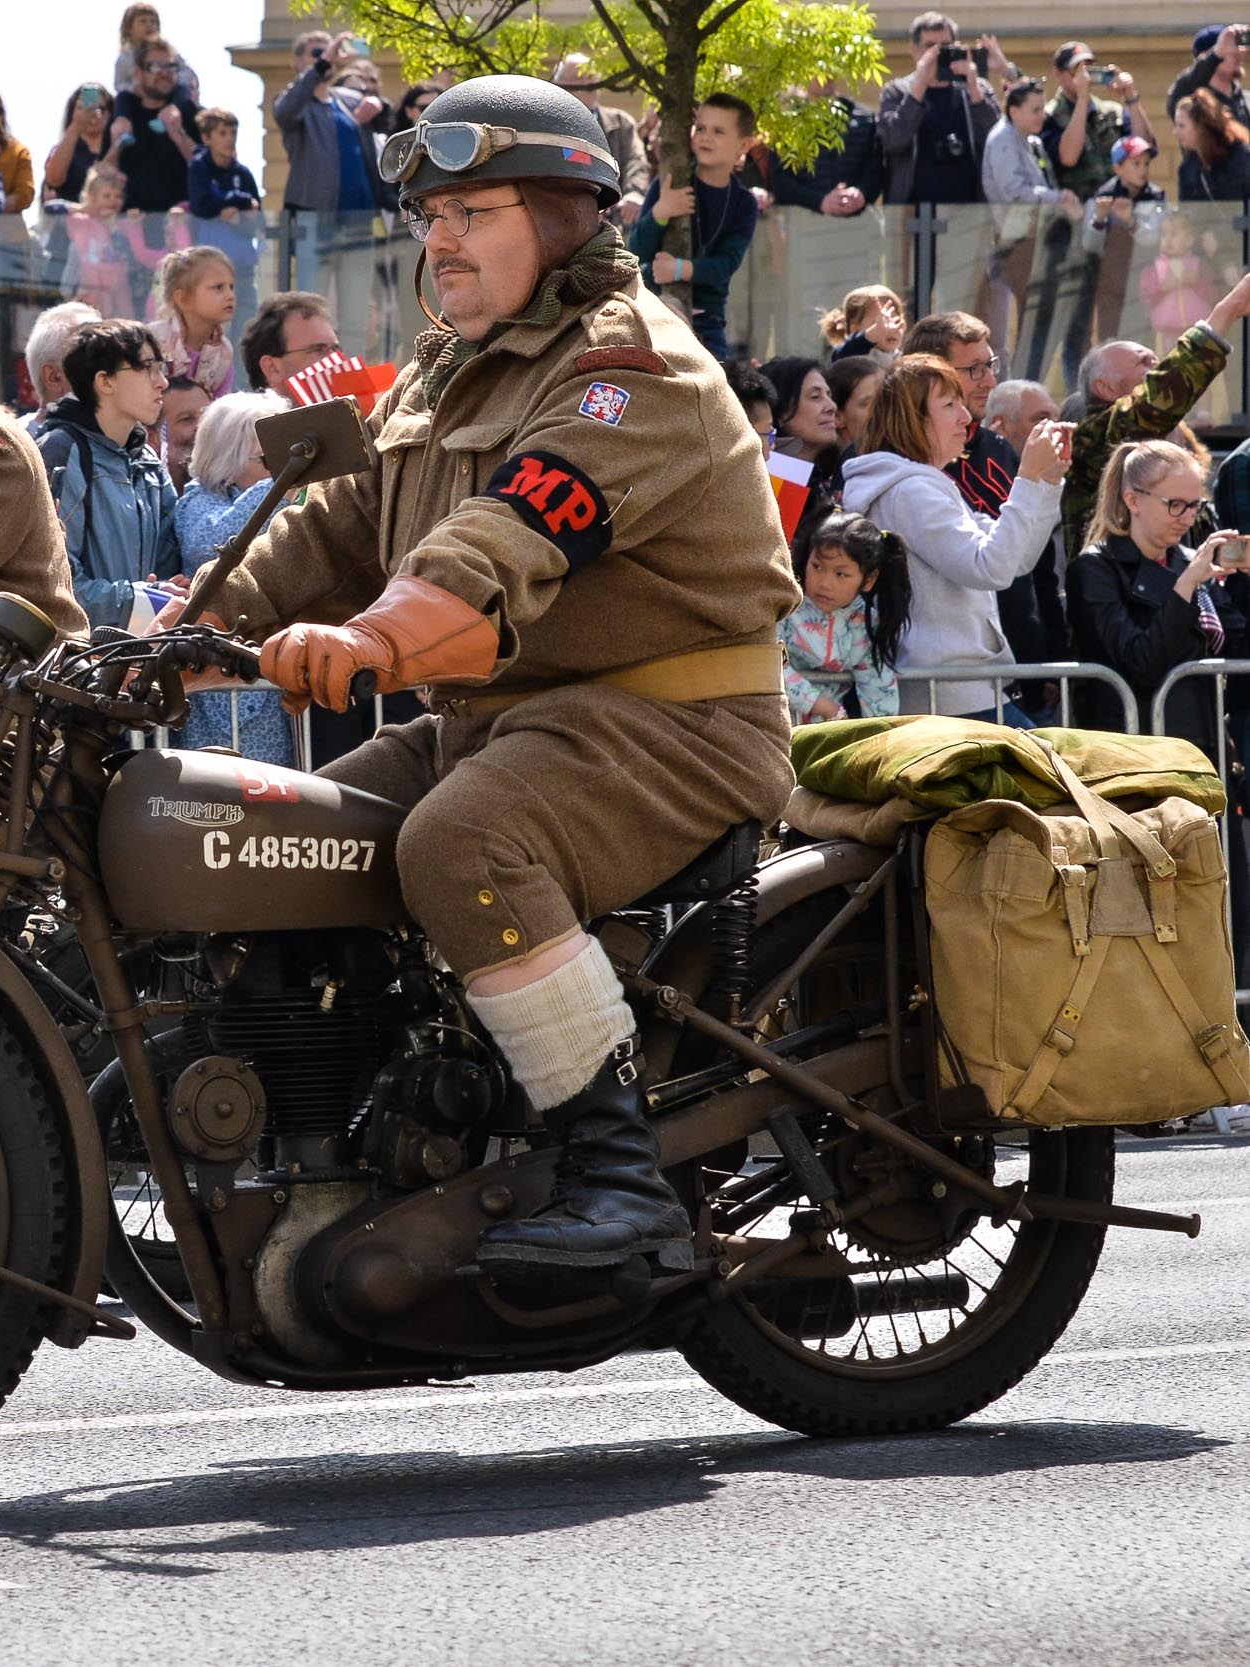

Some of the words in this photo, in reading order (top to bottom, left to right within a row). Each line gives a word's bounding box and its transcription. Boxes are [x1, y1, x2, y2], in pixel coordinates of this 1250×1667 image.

[498, 457, 597, 535] MP
[203, 830, 231, 869] C
[238, 836, 376, 872] 4853027
